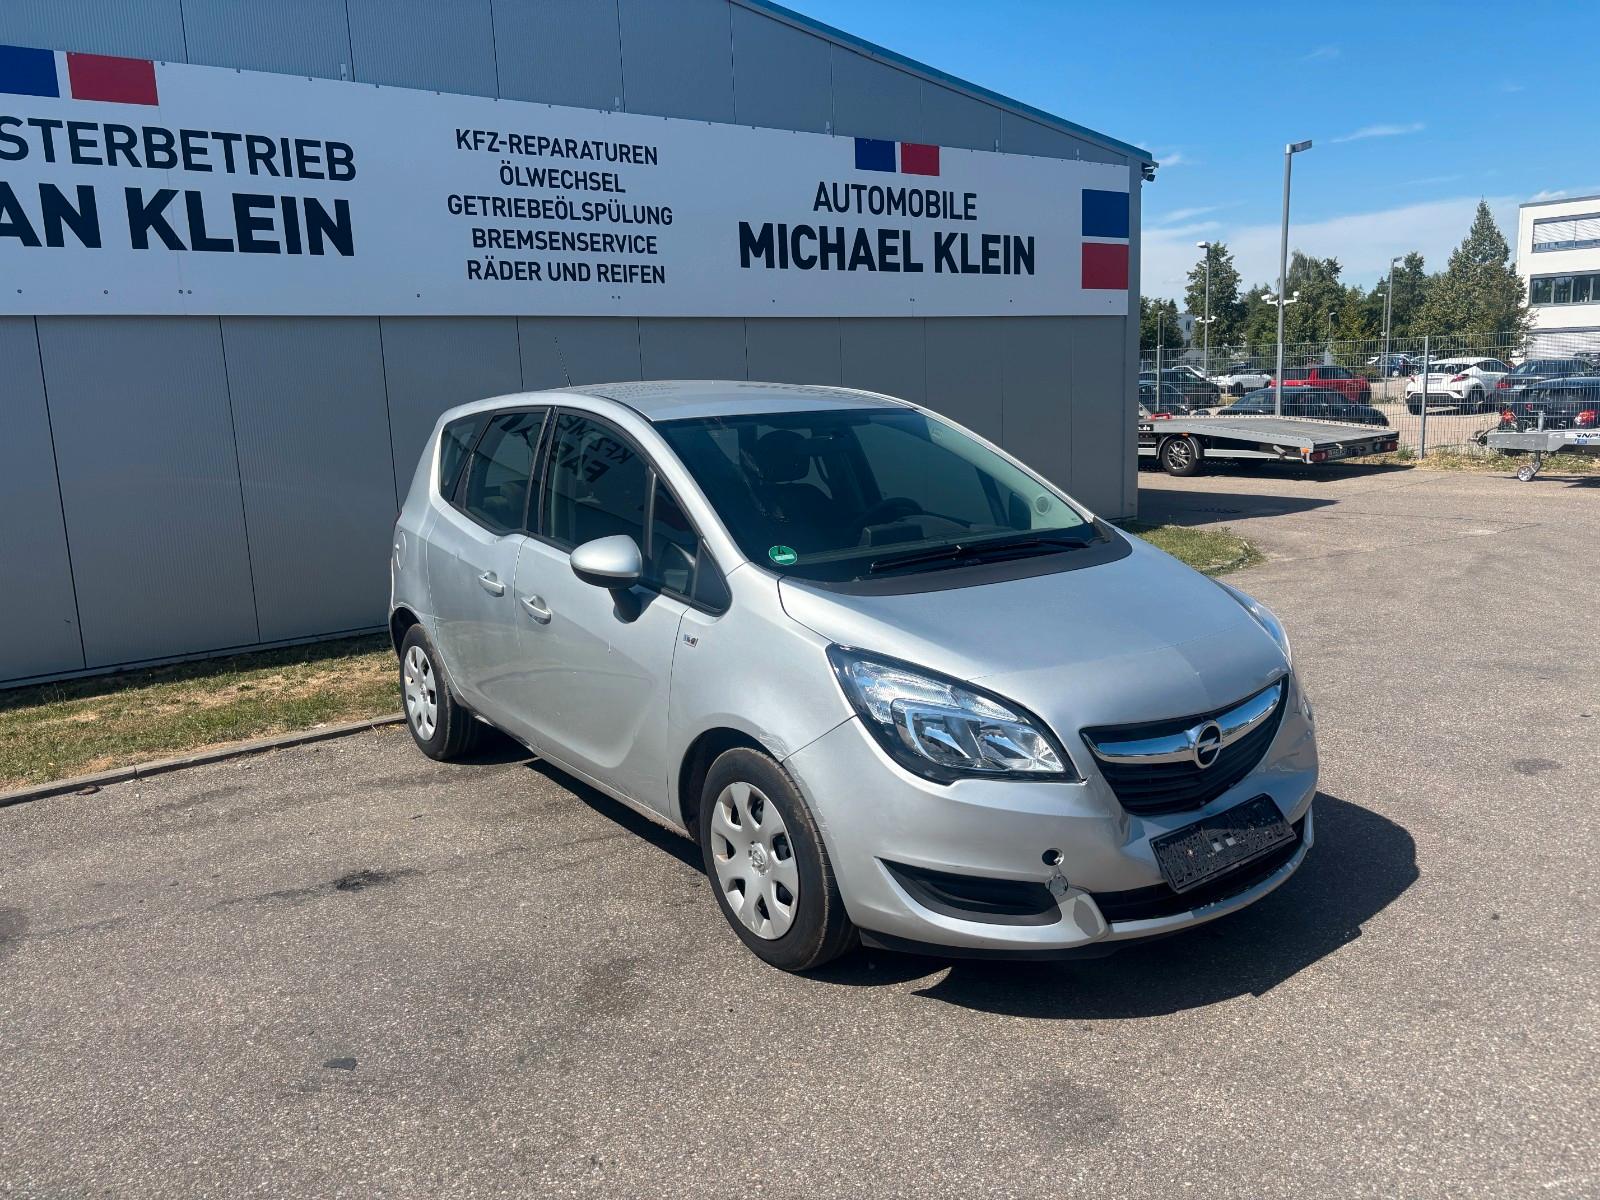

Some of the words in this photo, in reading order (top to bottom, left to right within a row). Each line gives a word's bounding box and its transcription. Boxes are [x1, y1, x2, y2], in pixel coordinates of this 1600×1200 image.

[0, 115, 357, 182] STERBETRIEB
[455, 128, 658, 166] KFZ-REPARATUREN
[499, 159, 627, 194] ÖLWECHSEL
[447, 193, 673, 226] GETRIEBEÖLSPÜLUNG
[812, 181, 978, 221] AUTOMOBILE
[124, 186, 355, 257] KLEIN
[471, 227, 658, 255] BREMSENSERVICE
[738, 220, 924, 273] MICHAEL
[933, 231, 1035, 276] KLEIN
[466, 254, 543, 282] RÄDER
[547, 261, 591, 282] UND
[596, 263, 666, 284] REIFEN
